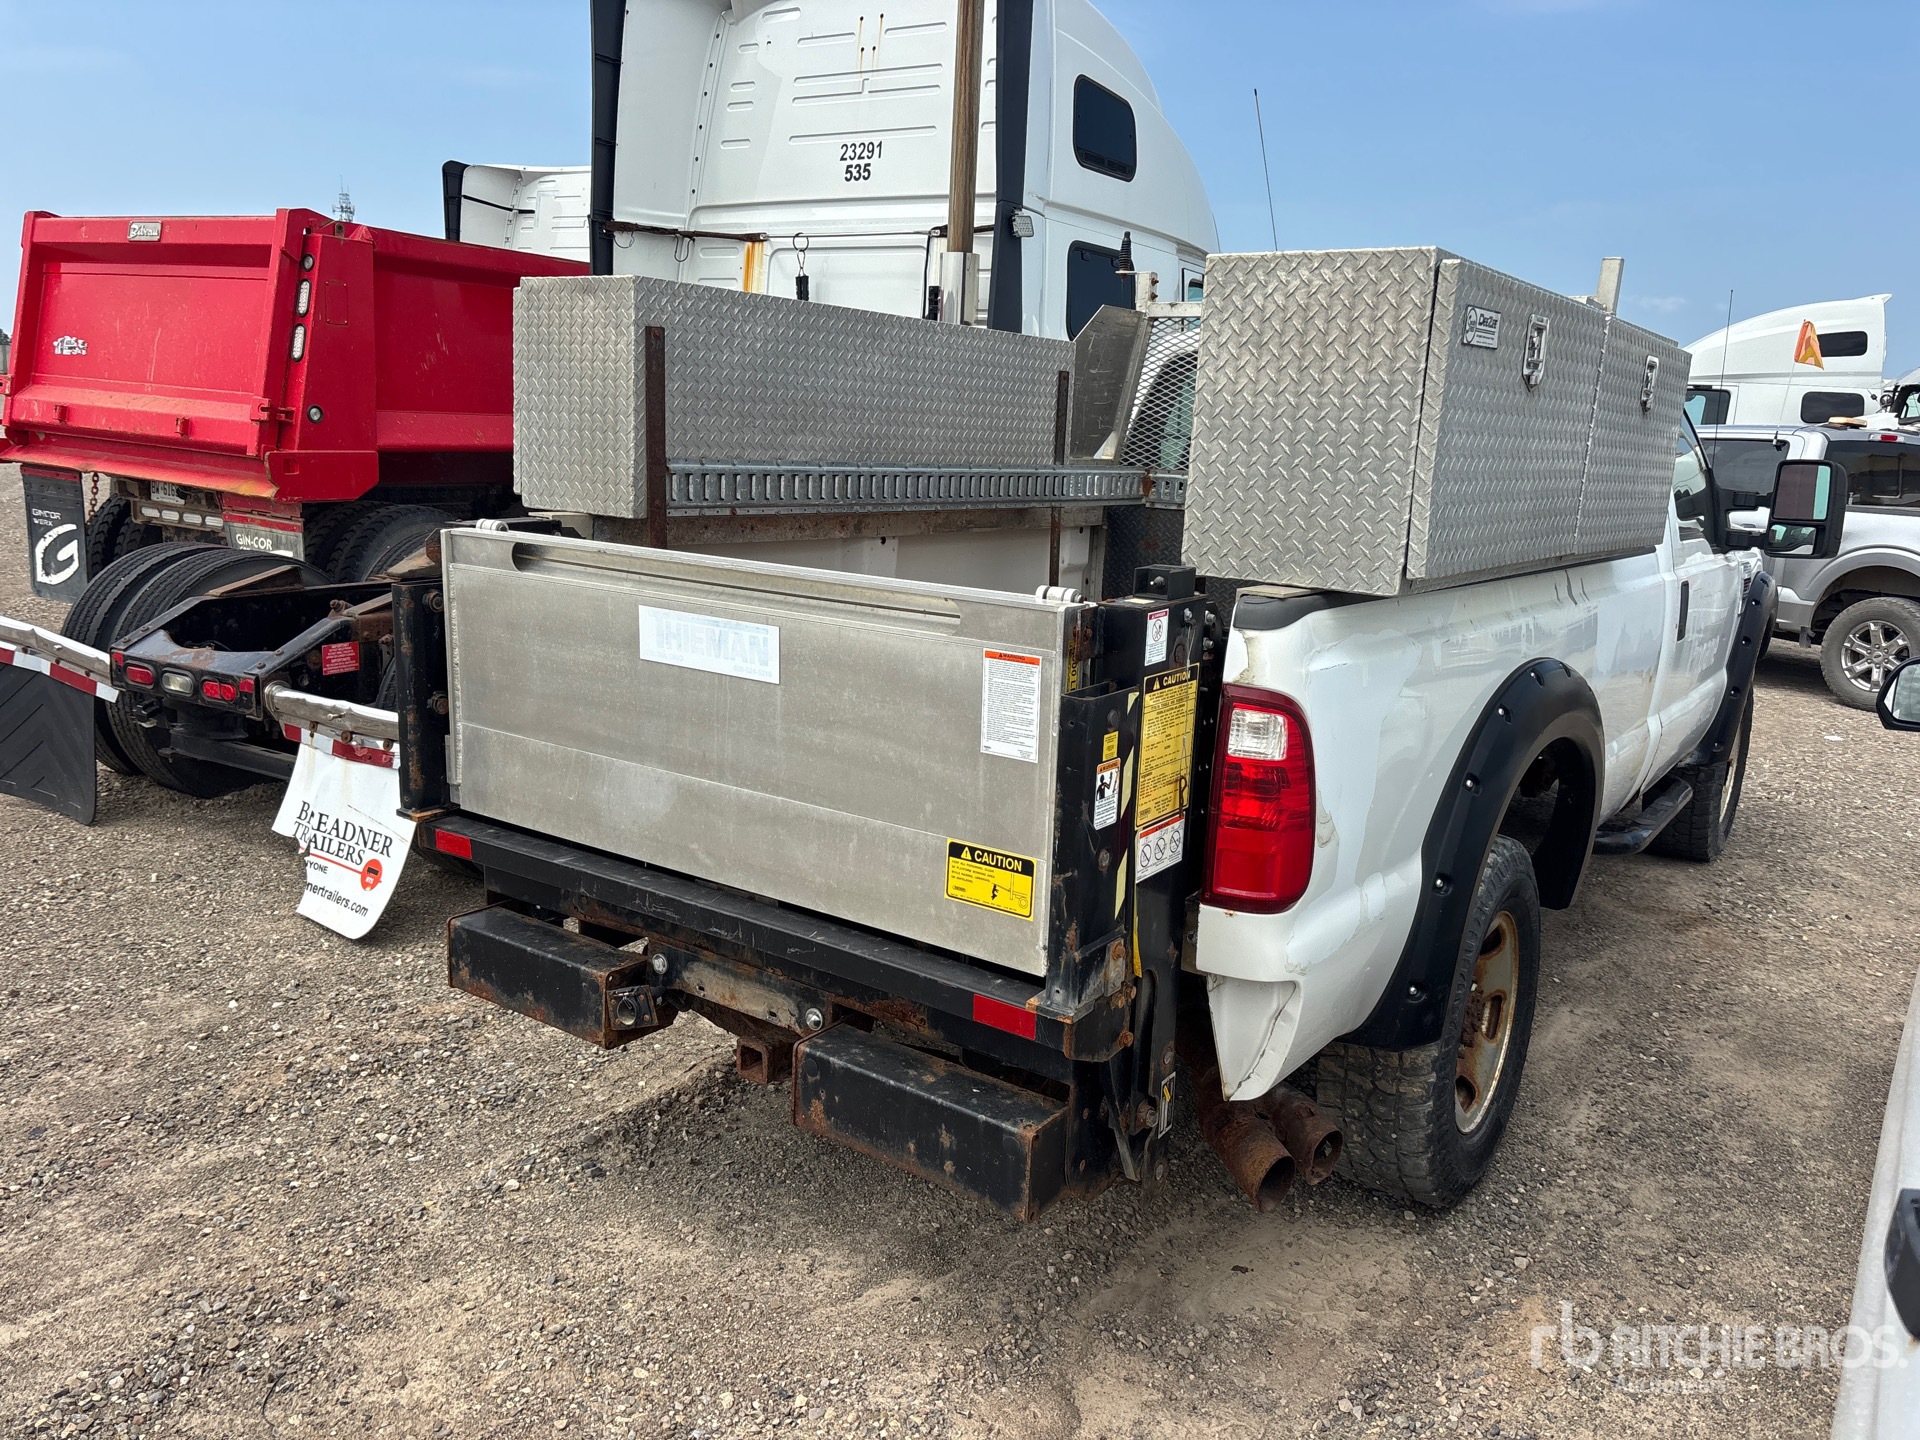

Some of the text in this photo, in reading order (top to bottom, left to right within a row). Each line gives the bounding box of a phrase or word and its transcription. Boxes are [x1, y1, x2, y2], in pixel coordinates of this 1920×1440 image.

[839, 140, 883, 162] 23291
[844, 162, 872, 182] 535
[32, 508, 61, 520] GINCOR
[235, 534, 273, 550] GIN-COR
[1162, 670, 1191, 686] CAUTION
[292, 821, 366, 866] TRAILERS
[974, 850, 1022, 872] CAUTION
